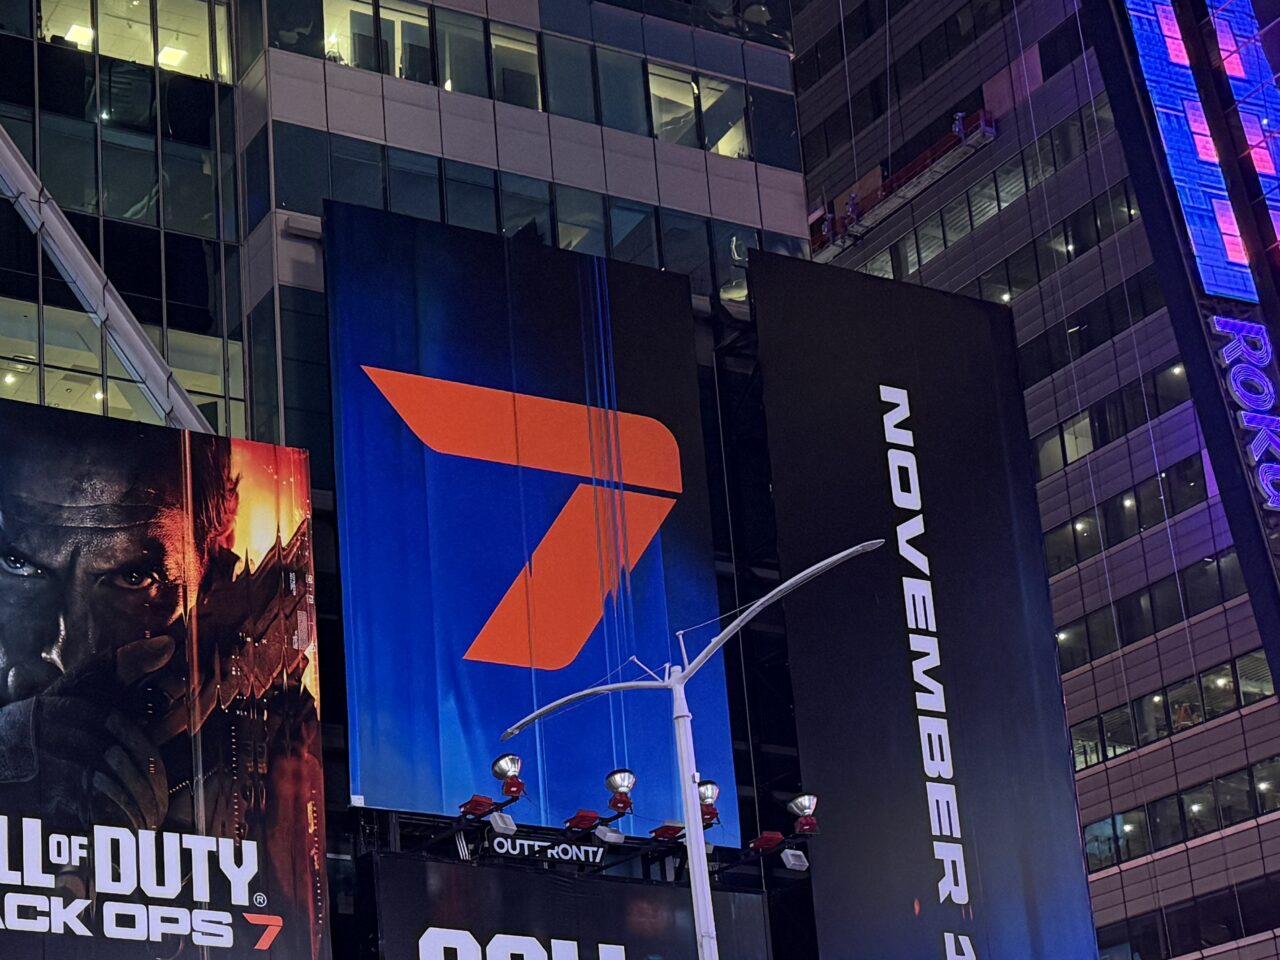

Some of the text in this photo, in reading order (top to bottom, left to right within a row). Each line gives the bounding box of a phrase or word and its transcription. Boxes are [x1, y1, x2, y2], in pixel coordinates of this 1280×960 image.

[361, 365, 683, 671] 7
[879, 384, 973, 906] NOVEMBER
[48, 833, 88, 867] OF
[102, 900, 234, 949] OPS
[242, 912, 284, 951] 7
